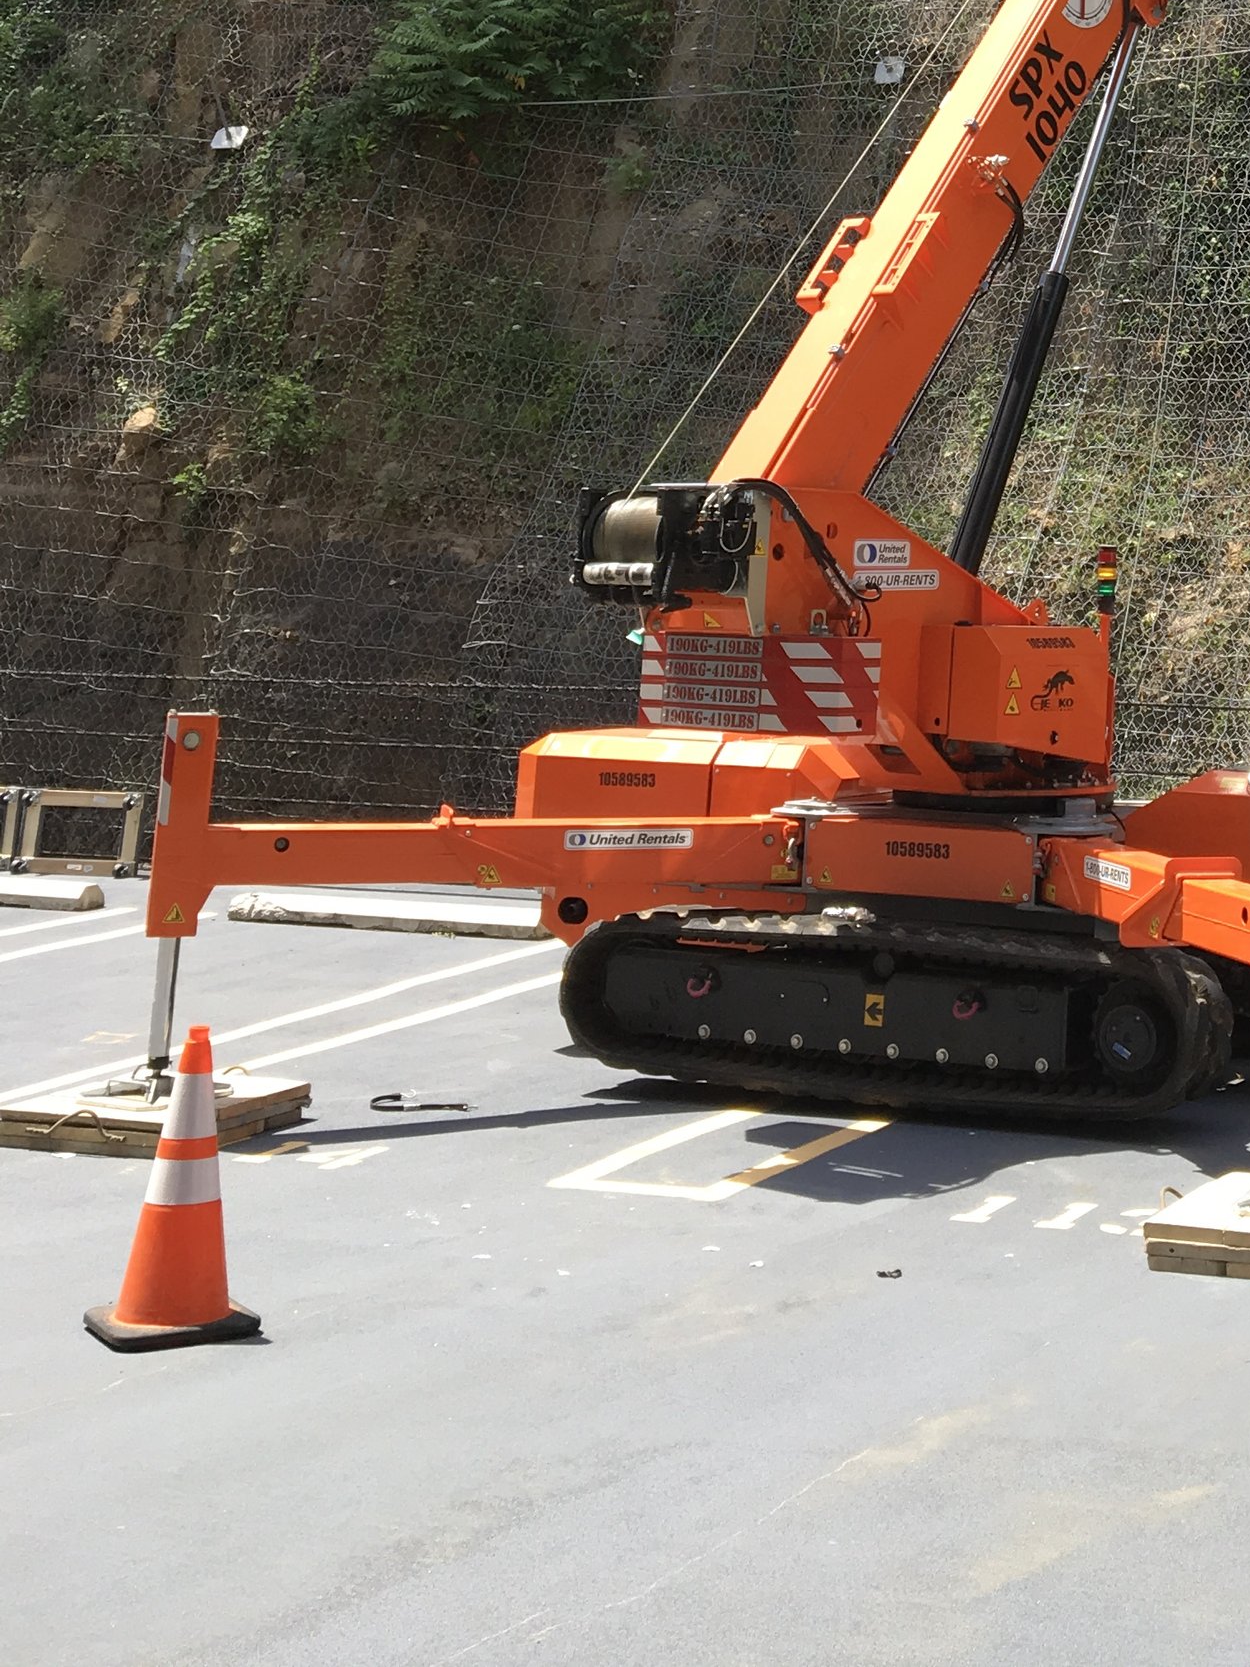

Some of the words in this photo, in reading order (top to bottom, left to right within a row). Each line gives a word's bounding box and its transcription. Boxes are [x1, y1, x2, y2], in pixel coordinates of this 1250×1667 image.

[1009, 29, 1064, 121] SPX
[1025, 61, 1086, 163] 1040
[879, 543, 906, 553] United
[878, 554, 907, 564] Rentals
[669, 637, 760, 655] 190KG-419LBS
[668, 661, 758, 679] 190KG-419LBS
[666, 684, 756, 705] 190KG-419LBS
[664, 708, 754, 729] 190KG-419LBS
[599, 772, 656, 788] 10589583
[589, 834, 634, 845] United
[637, 833, 687, 845] Rentals
[886, 841, 950, 859] 10589583
